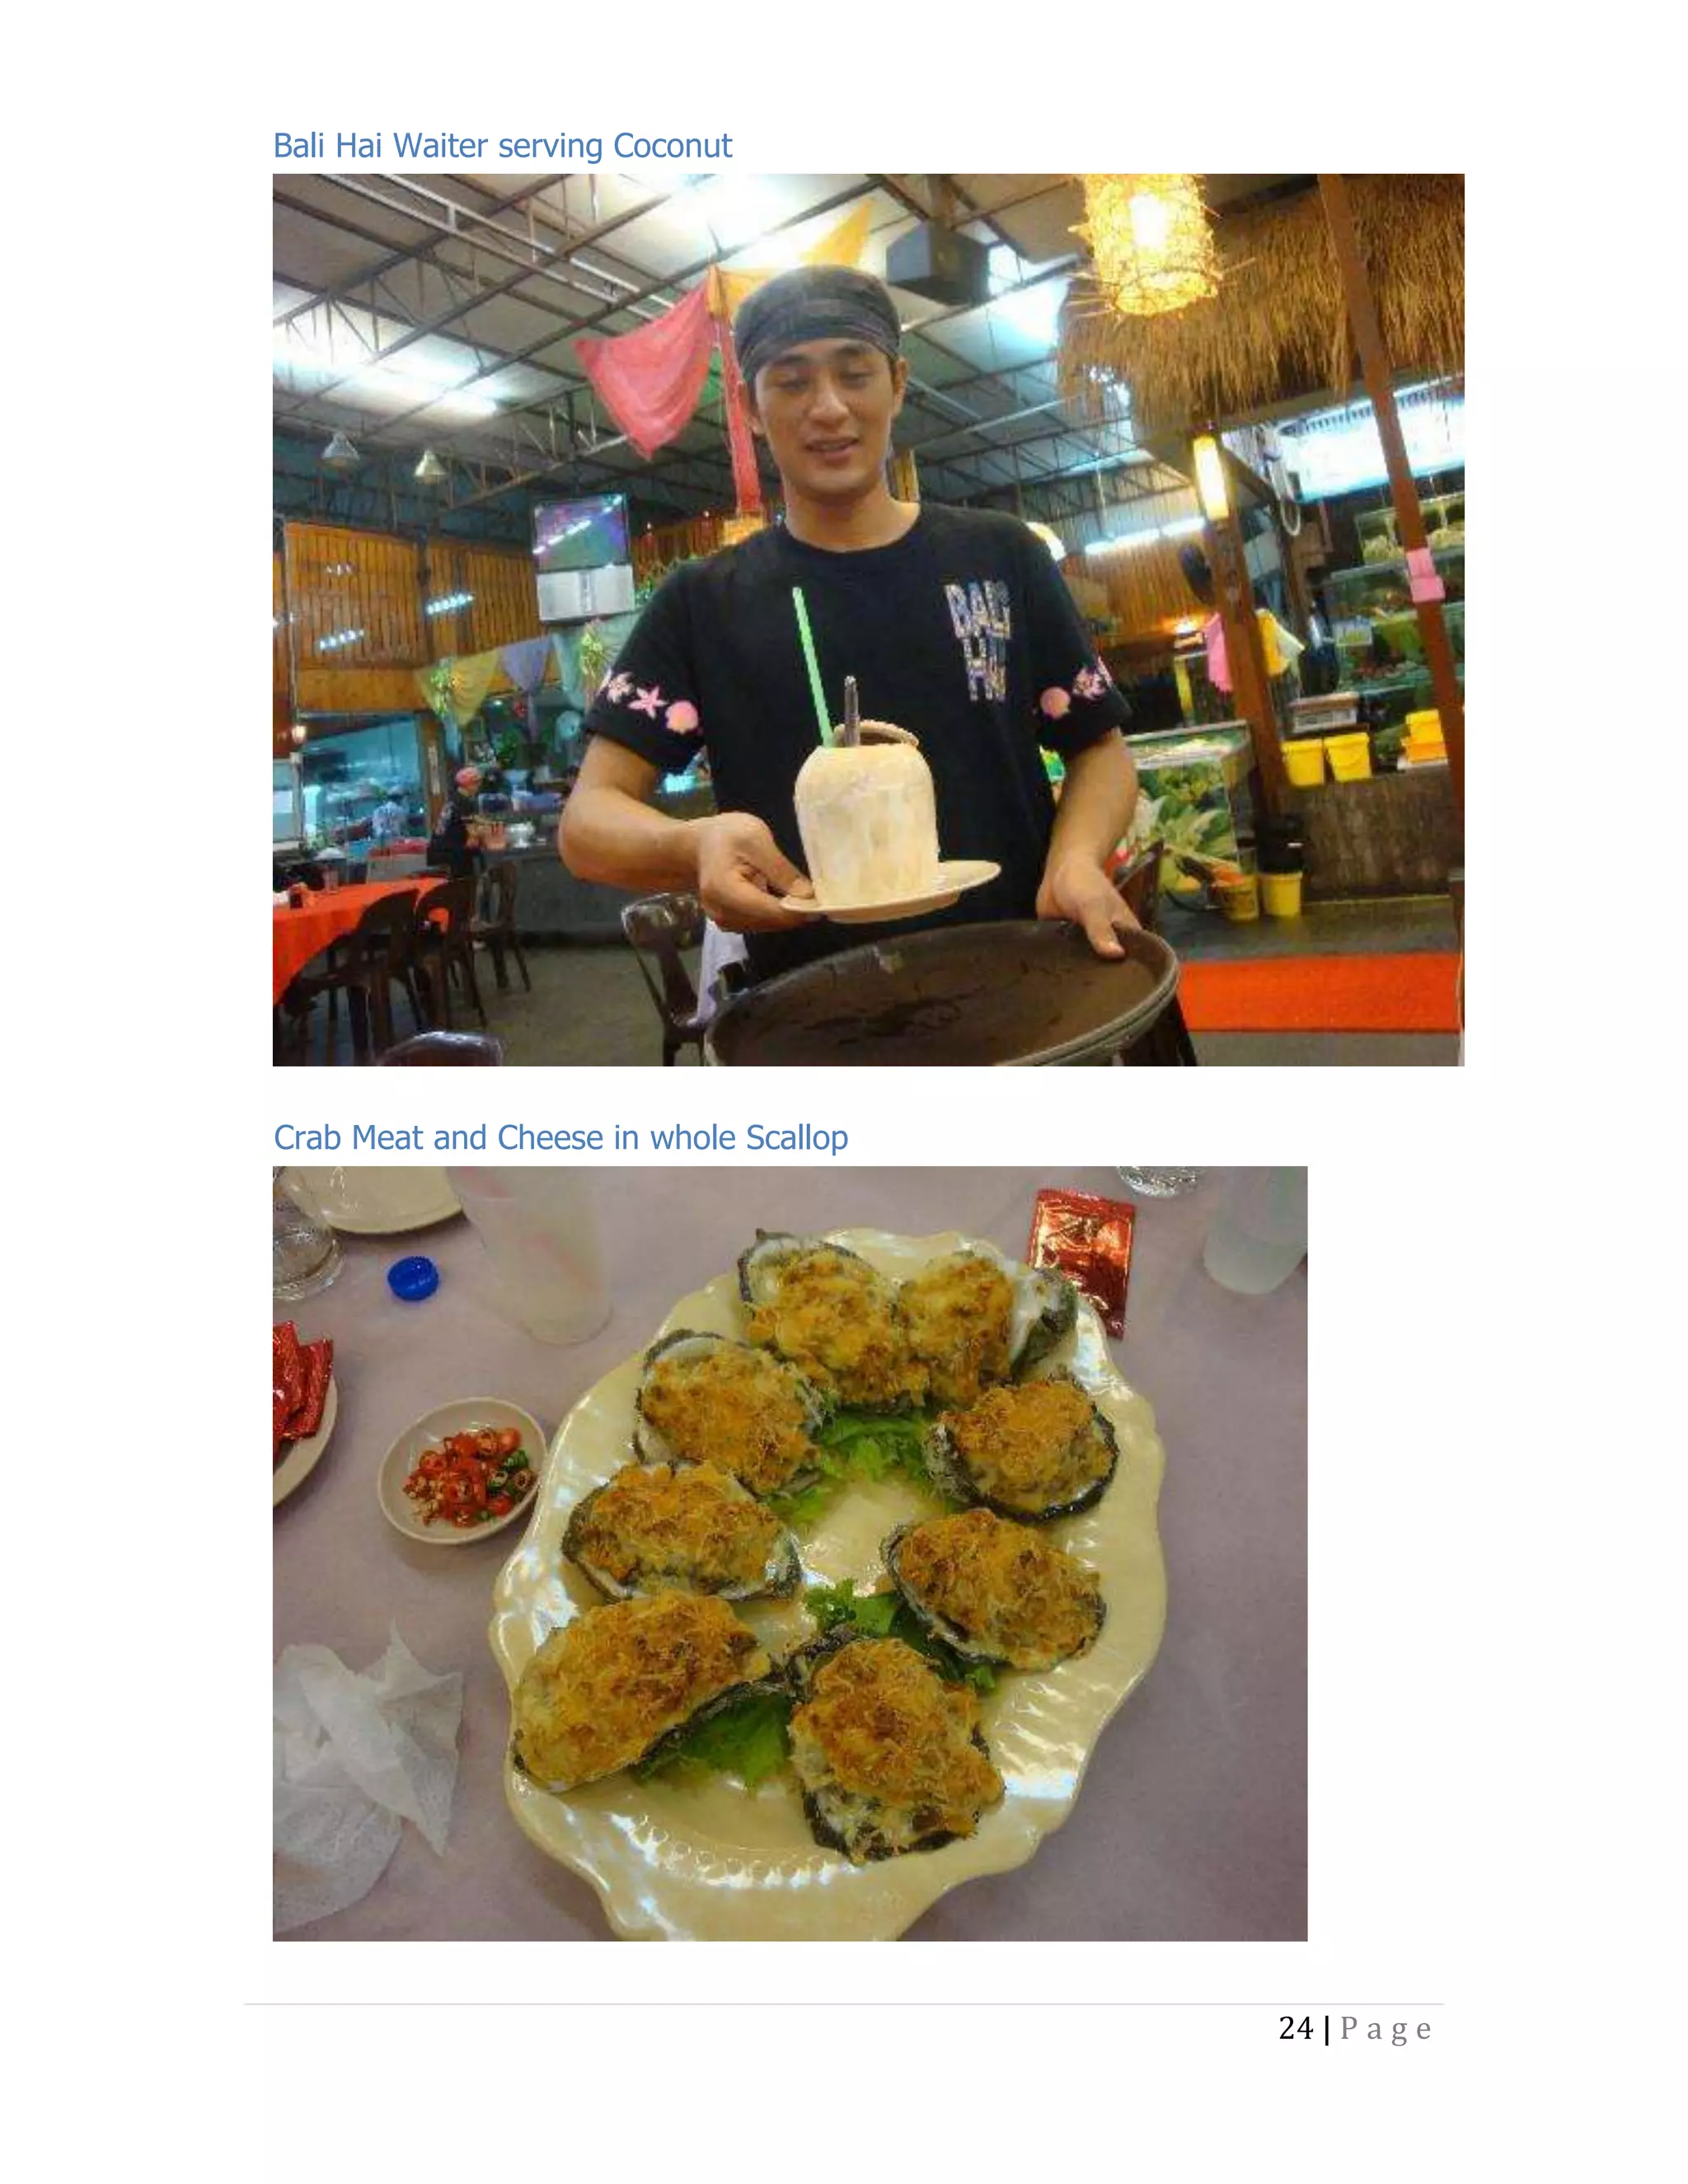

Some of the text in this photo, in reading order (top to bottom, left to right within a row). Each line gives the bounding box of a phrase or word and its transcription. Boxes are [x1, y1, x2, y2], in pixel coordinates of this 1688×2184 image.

[275, 132, 733, 164] Bali Hai Waiter serving Coconut
[275, 1123, 848, 1156] Crab Meat and Cheese in whole Scallop
[1280, 2016, 1313, 2039] 24
